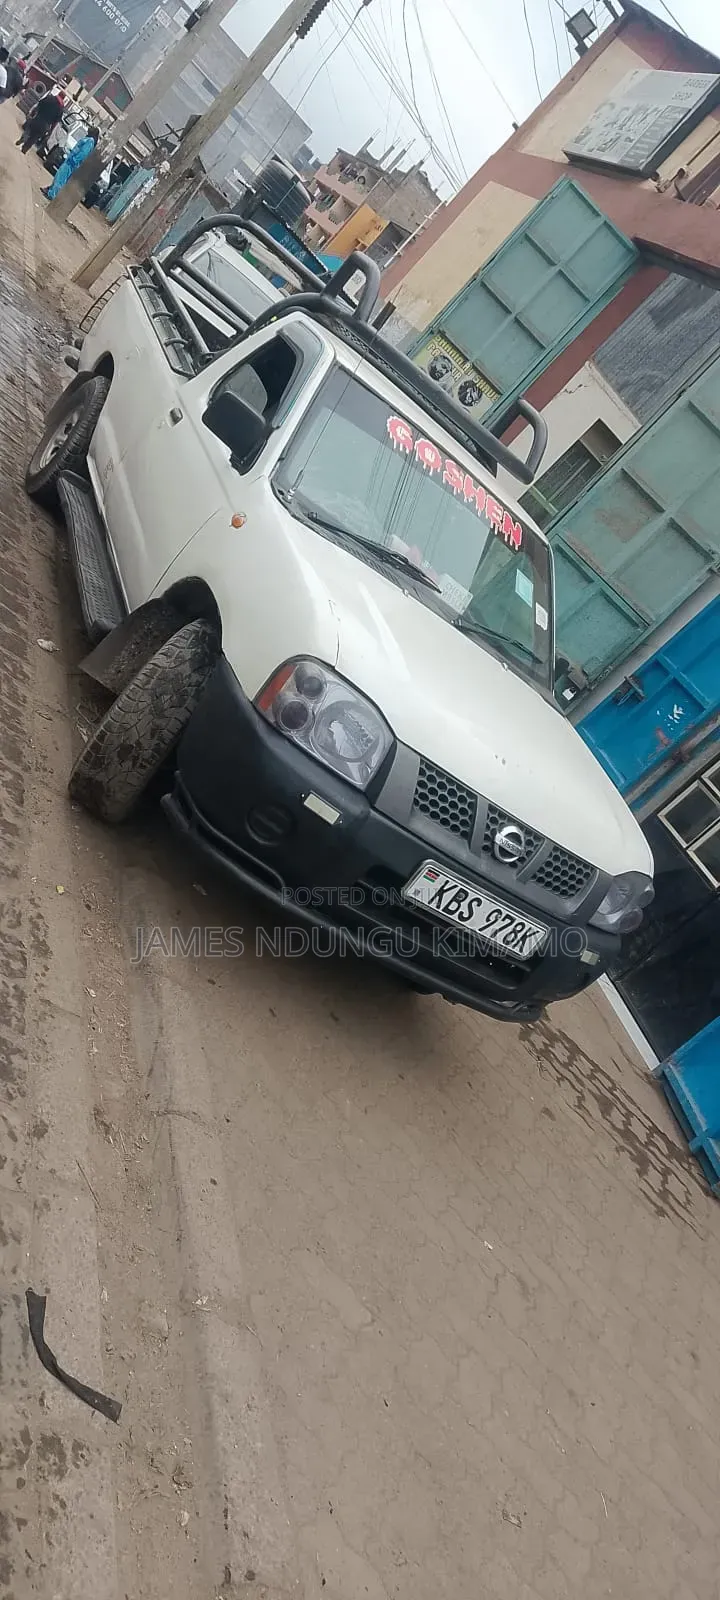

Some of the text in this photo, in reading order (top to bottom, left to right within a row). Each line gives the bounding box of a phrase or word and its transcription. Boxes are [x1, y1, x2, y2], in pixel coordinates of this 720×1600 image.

[386, 415, 523, 551] GOSHEN
[428, 880, 539, 953] KBS 978K
